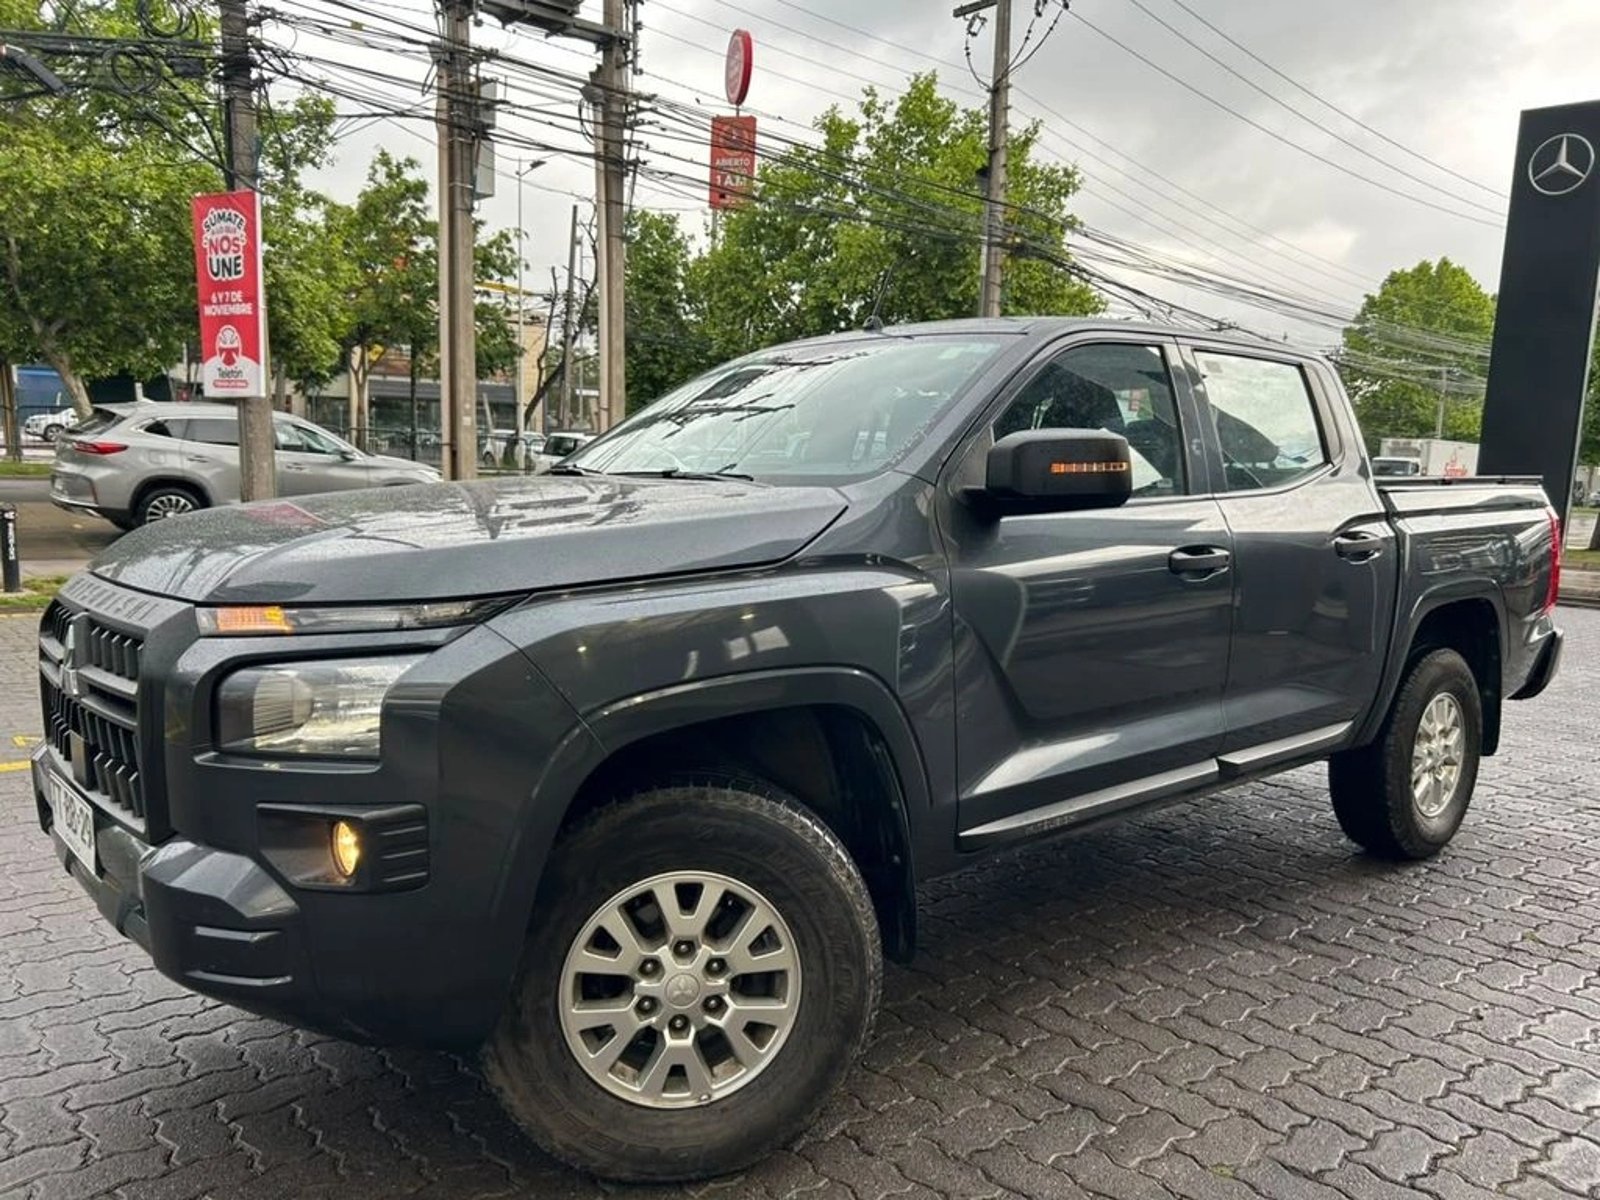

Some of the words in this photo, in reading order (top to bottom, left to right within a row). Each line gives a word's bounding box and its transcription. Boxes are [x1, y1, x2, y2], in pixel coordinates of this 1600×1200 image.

[204, 209, 244, 232] SÚMATE
[209, 235, 241, 255] NOS
[209, 255, 242, 277] UNE
[231, 290, 243, 302] DE
[204, 303, 253, 316] NOVIEMBRE
